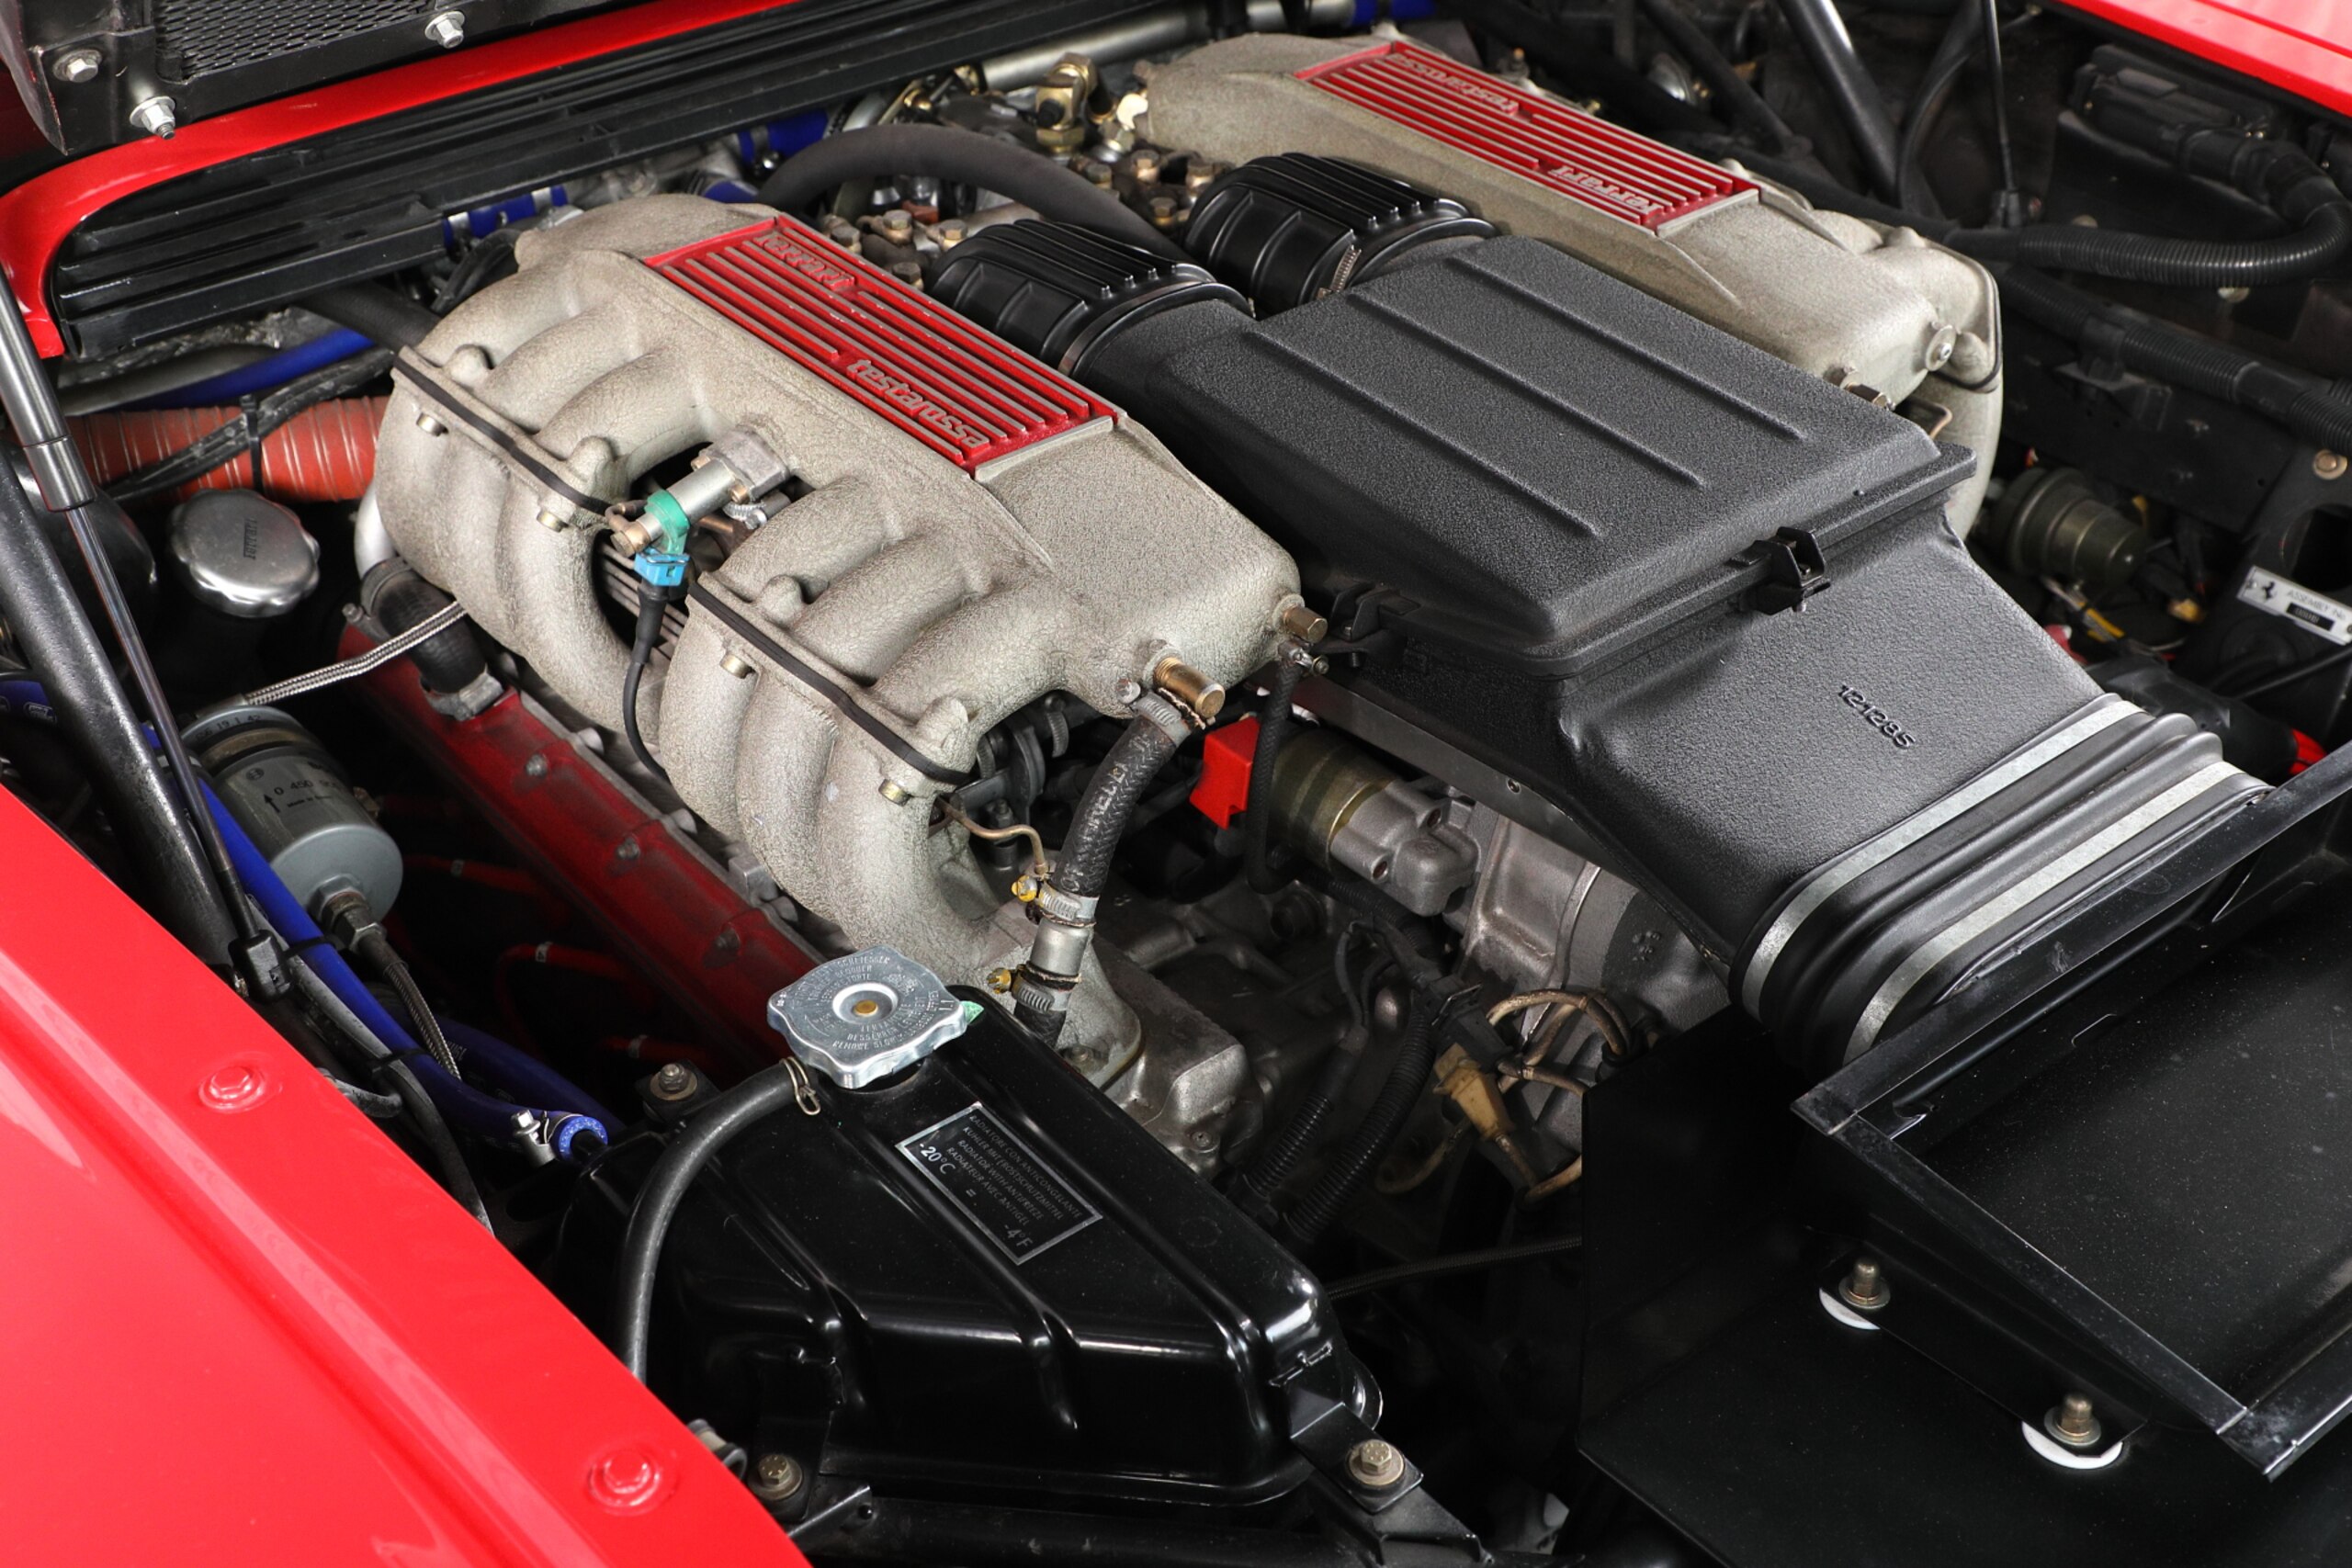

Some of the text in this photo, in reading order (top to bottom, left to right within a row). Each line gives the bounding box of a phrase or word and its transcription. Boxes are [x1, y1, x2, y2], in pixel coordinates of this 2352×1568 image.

[1386, 53, 1518, 112] testarossa
[1549, 164, 1664, 215] Ferrari
[754, 231, 855, 290] Ferrari
[846, 357, 991, 452] testarossa
[1838, 684, 1916, 749] 121285
[956, 1139, 990, 1171] RADIATOR
[987, 1168, 1009, 1188] WITH
[968, 1114, 1008, 1150] RADIATORE
[1004, 1145, 1022, 1163] CON
[945, 1146, 985, 1182] RADIATEUR
[981, 1179, 1001, 1199] AVEC
